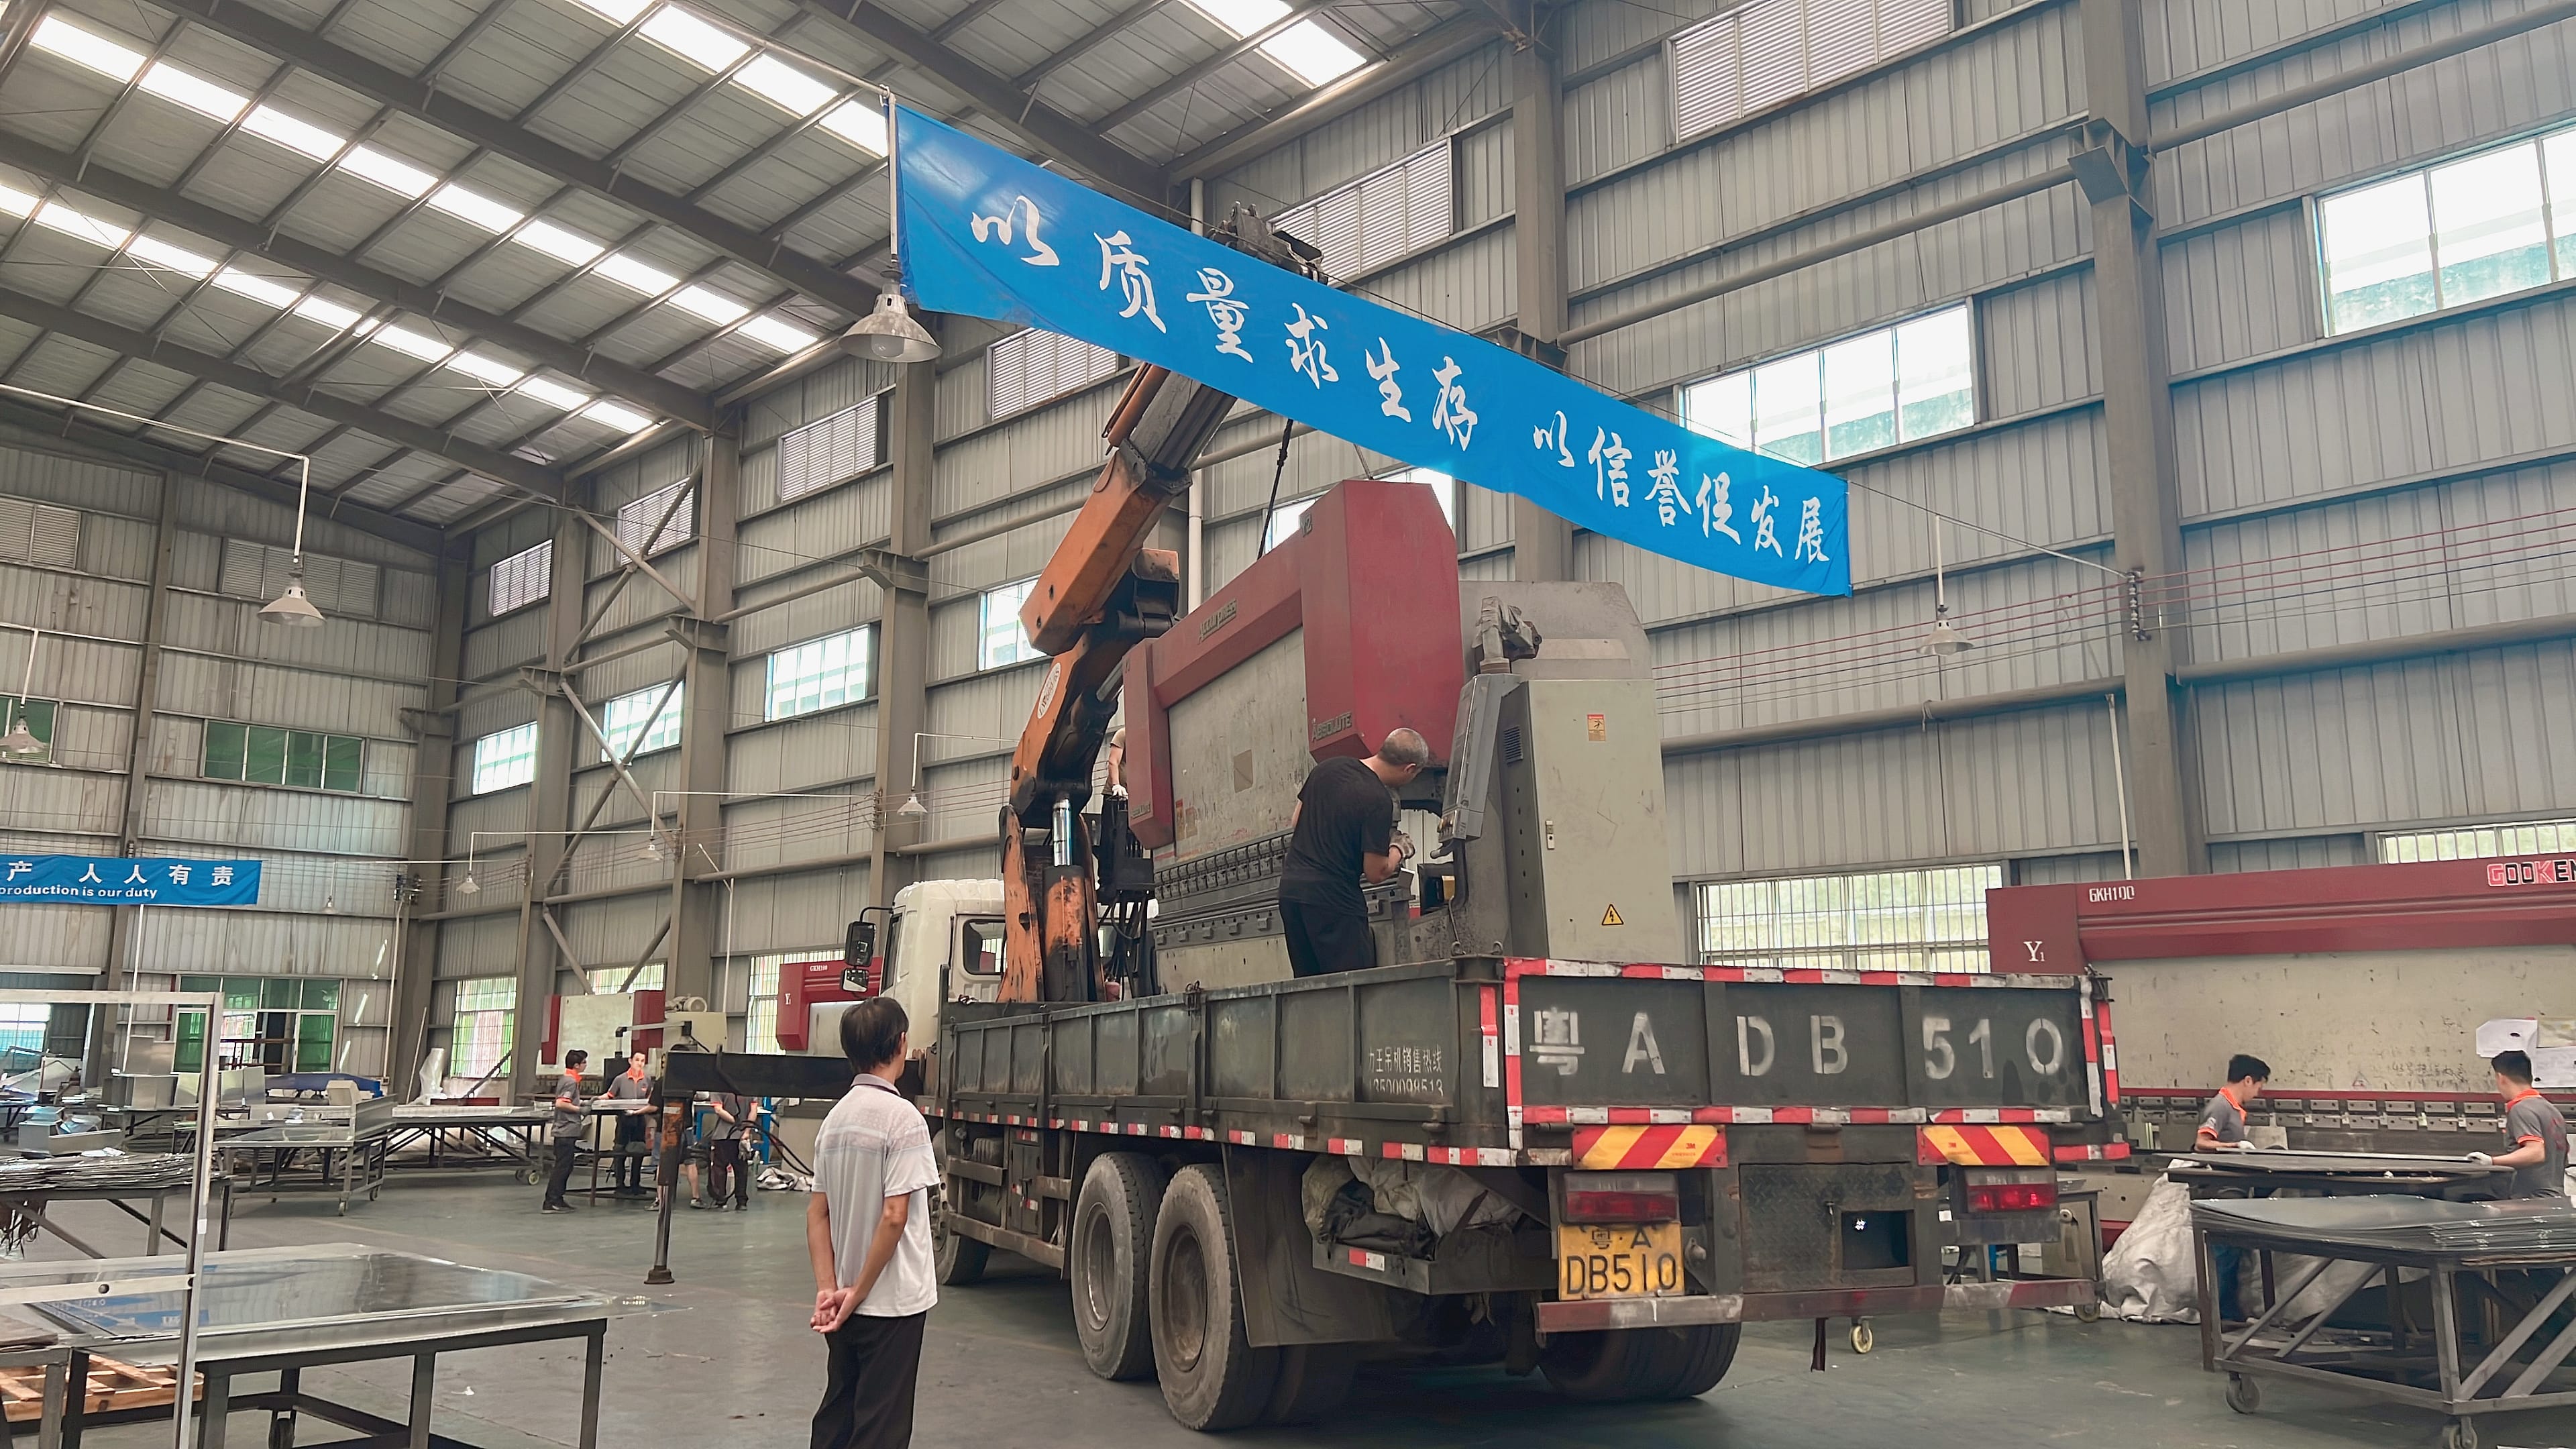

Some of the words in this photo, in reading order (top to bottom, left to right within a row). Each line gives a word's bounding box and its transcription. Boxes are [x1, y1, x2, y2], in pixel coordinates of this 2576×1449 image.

[971, 196, 1477, 451] 以质量求生存
[1534, 411, 1831, 564] 以信誉促发展
[7, 861, 33, 881] 产
[78, 863, 233, 886] 人人有责
[83, 886, 94, 896] is
[125, 888, 157, 899] duty
[1529, 1007, 1585, 1075] 粤
[1622, 1012, 1665, 1074] A
[1737, 1015, 1774, 1076] D
[1811, 1015, 1848, 1075] B
[1567, 1253, 1676, 1295] DB510
